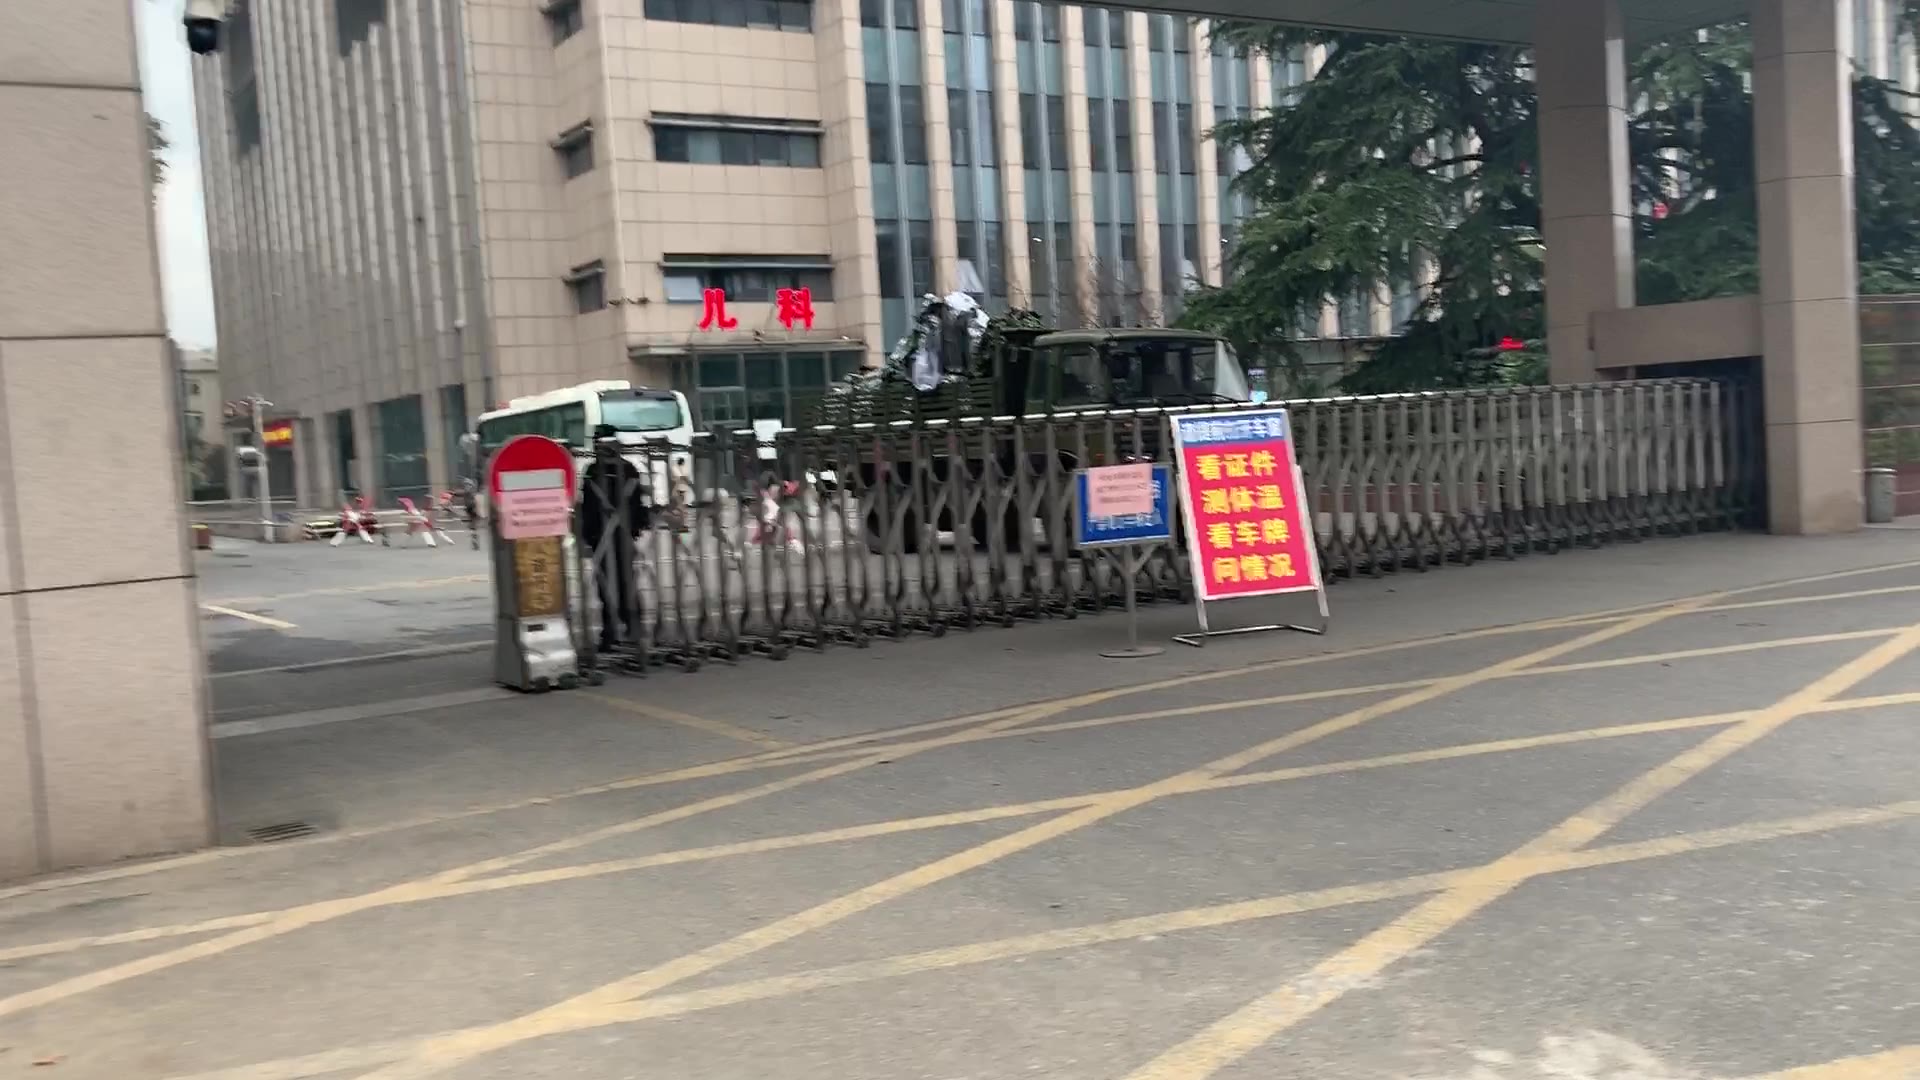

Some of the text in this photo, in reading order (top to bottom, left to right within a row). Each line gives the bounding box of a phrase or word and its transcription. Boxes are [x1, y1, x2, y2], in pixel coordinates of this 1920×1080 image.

[698, 287, 815, 332] 儿科
[1196, 450, 1278, 481] 看证件
[1201, 484, 1286, 515] 测体温
[1206, 518, 1291, 549] 看车牌
[1212, 553, 1297, 584] 问情况
